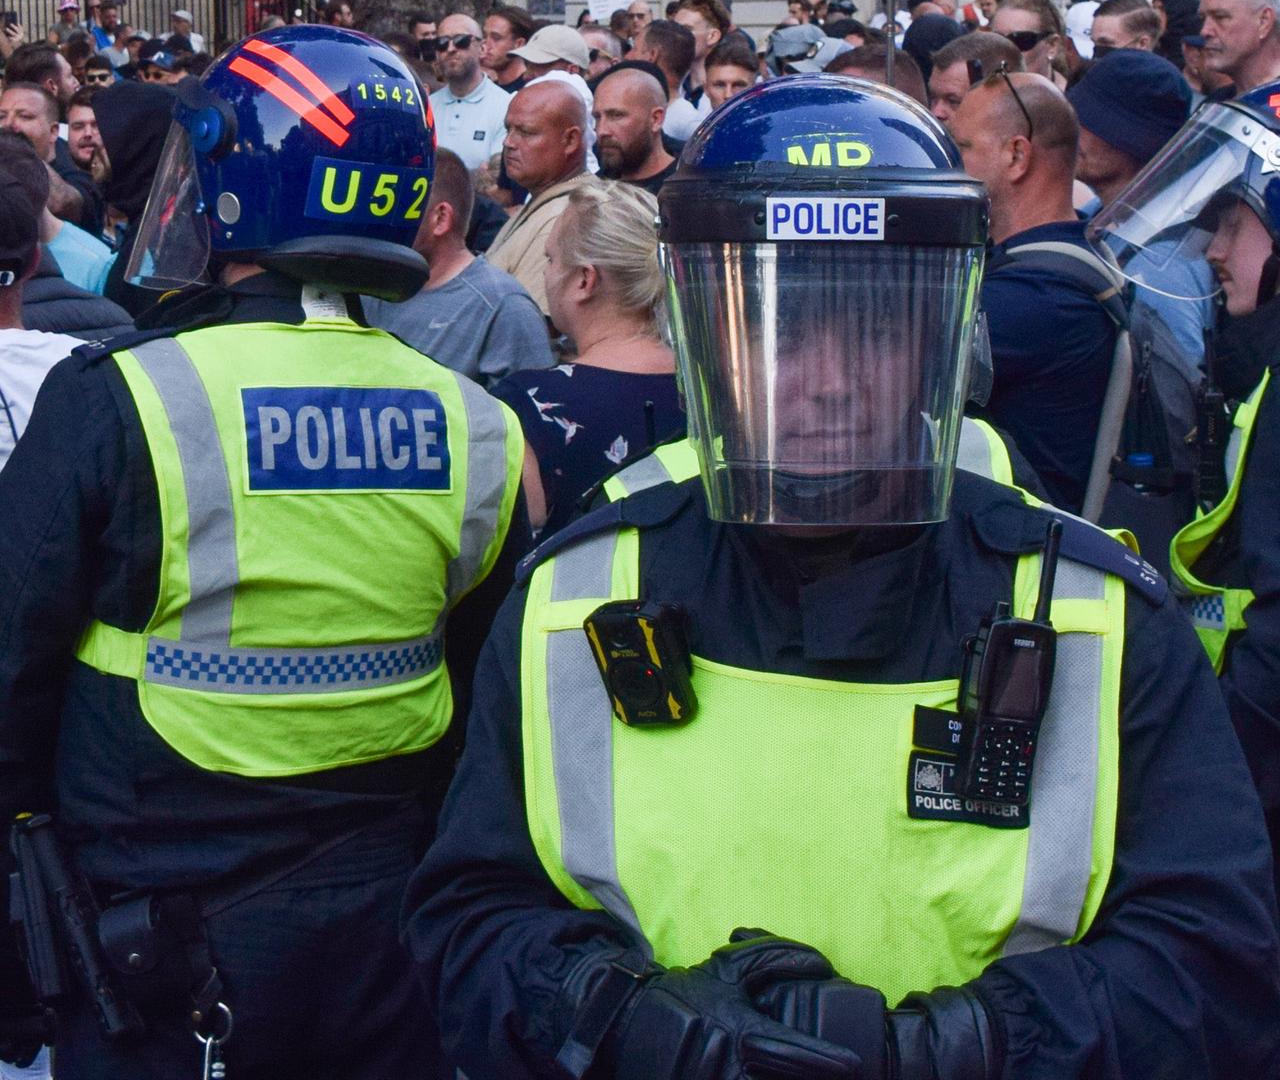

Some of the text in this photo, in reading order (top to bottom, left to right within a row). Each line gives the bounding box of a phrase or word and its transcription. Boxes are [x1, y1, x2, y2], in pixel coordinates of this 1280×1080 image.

[357, 83, 415, 106] 1542
[773, 203, 879, 235] POLICE
[257, 405, 443, 471] POLICE
[915, 795, 1020, 817] POLICE OFFICER
